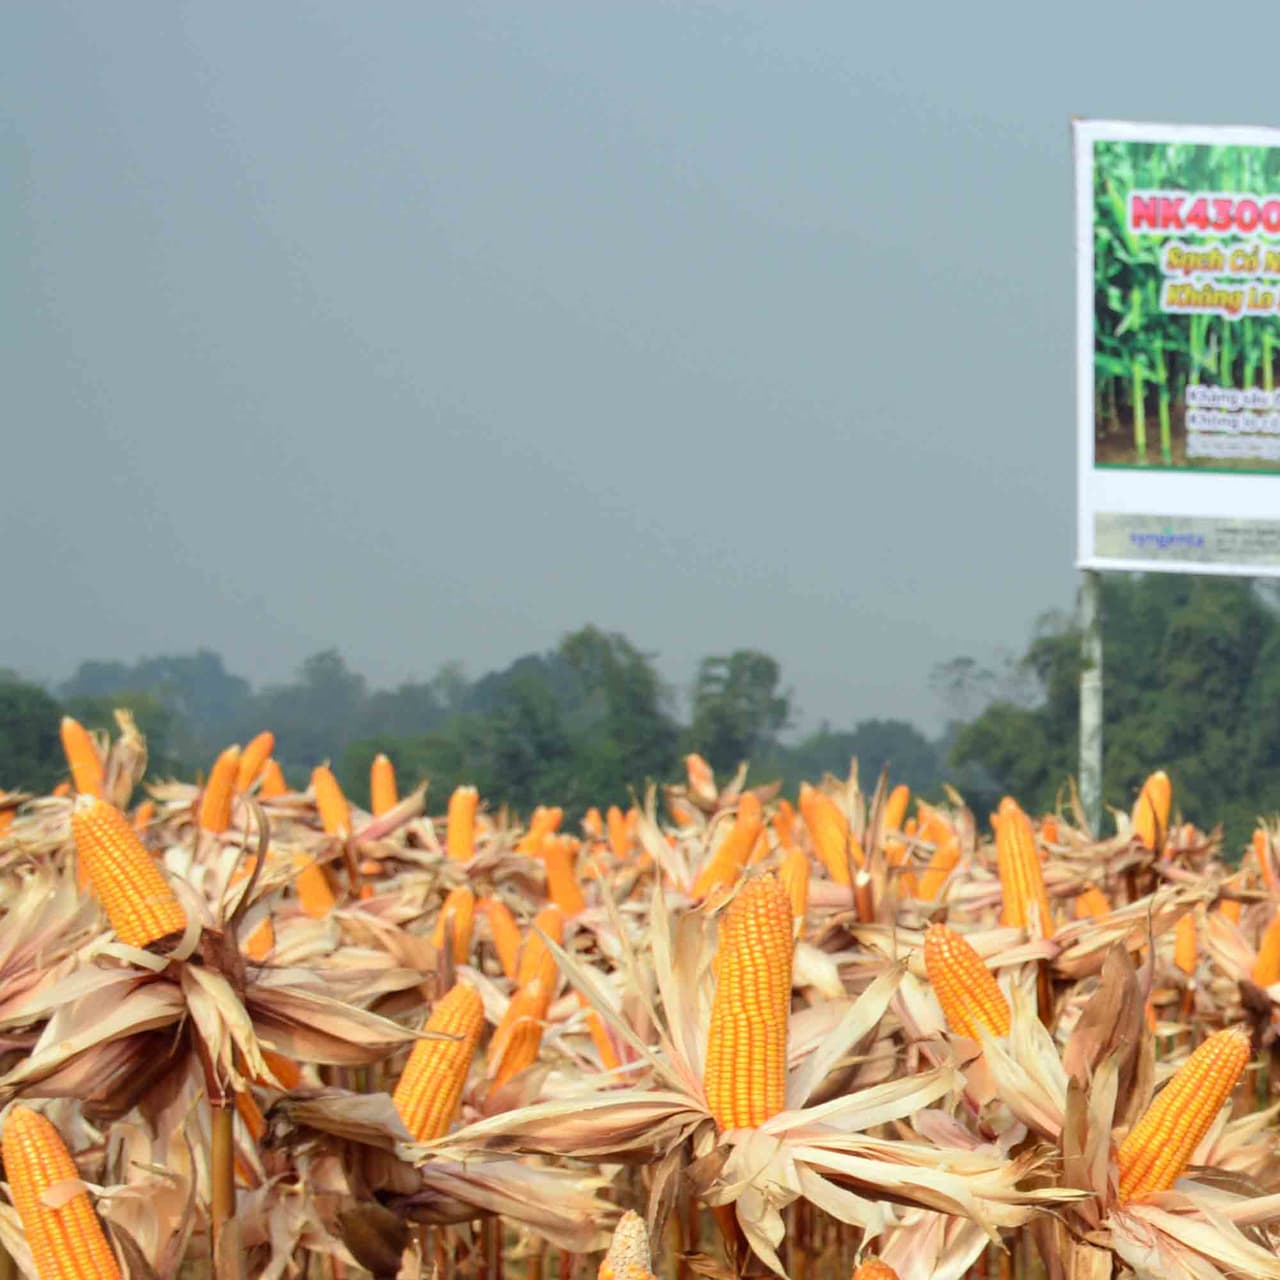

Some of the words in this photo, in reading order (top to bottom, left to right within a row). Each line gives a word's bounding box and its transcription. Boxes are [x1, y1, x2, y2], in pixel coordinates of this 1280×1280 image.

[1166, 246, 1224, 276] Sạch
[1166, 281, 1242, 315] Không
[1248, 286, 1273, 311] Lo
